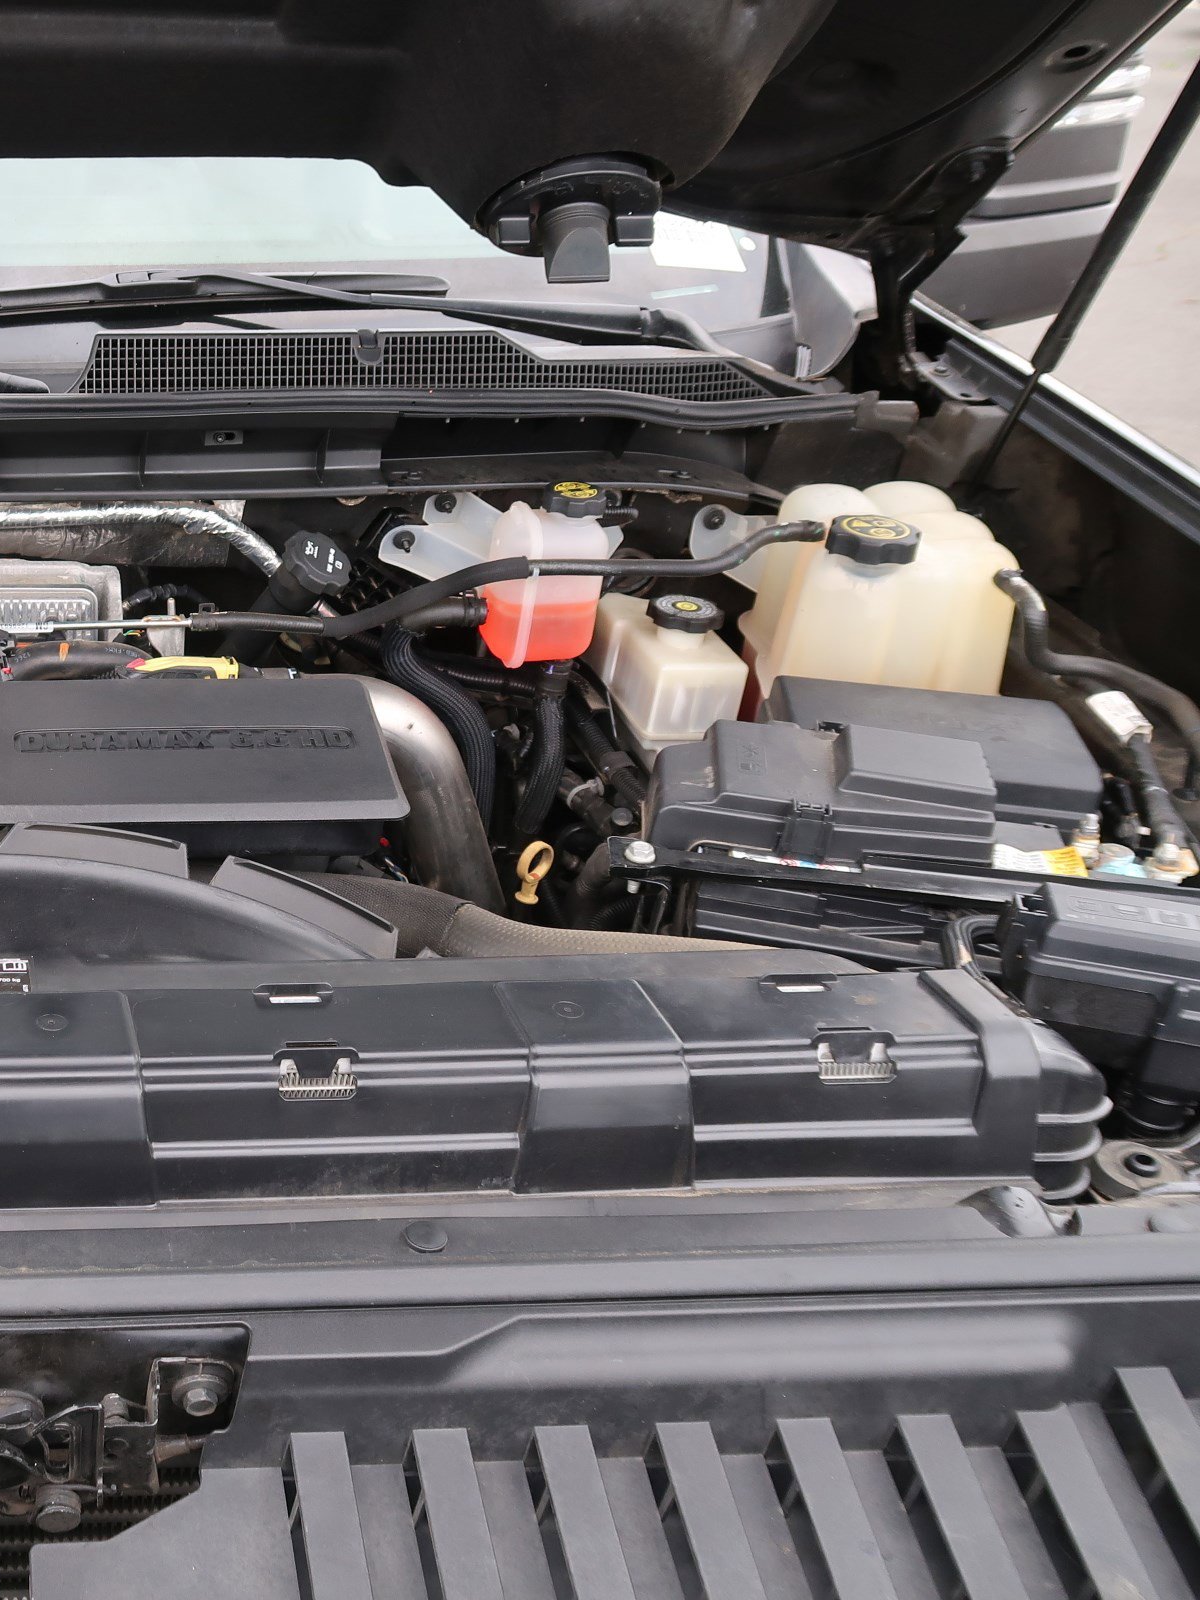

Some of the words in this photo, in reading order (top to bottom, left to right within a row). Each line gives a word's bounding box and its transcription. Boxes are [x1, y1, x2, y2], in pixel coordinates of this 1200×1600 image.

[20, 729, 215, 753] DURAMAX
[231, 729, 291, 749] 6.6
[300, 728, 352, 749] HD
